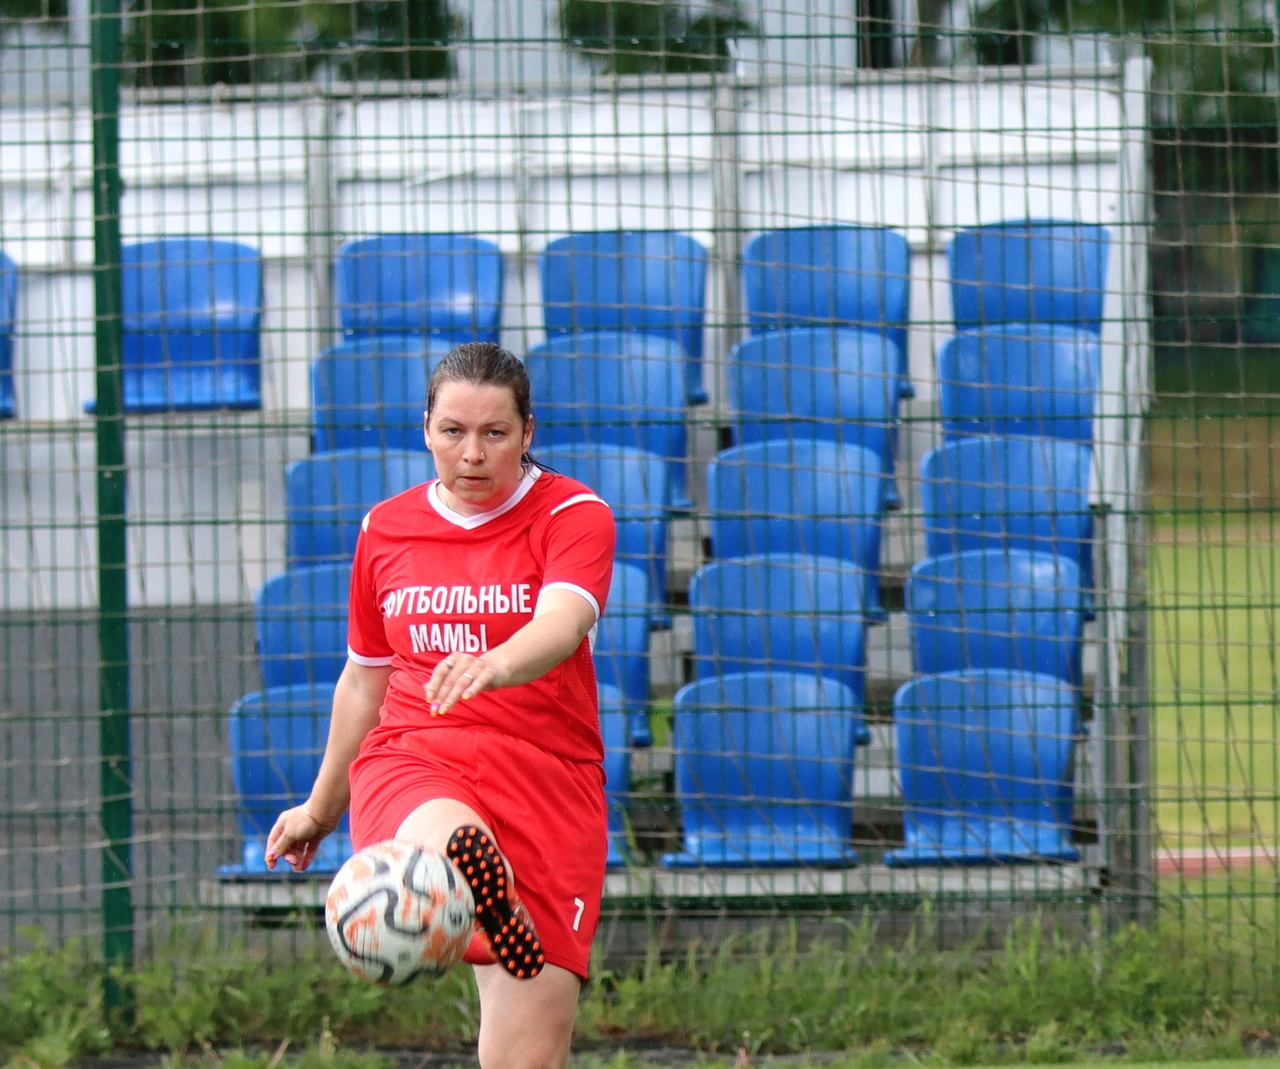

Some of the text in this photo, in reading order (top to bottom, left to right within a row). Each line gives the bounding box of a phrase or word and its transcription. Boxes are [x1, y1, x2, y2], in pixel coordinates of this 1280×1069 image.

[383, 583, 533, 619] ФУТБОЛЬНЫЕ
[409, 622, 489, 654] МАМЫ
[573, 897, 585, 932] 7
